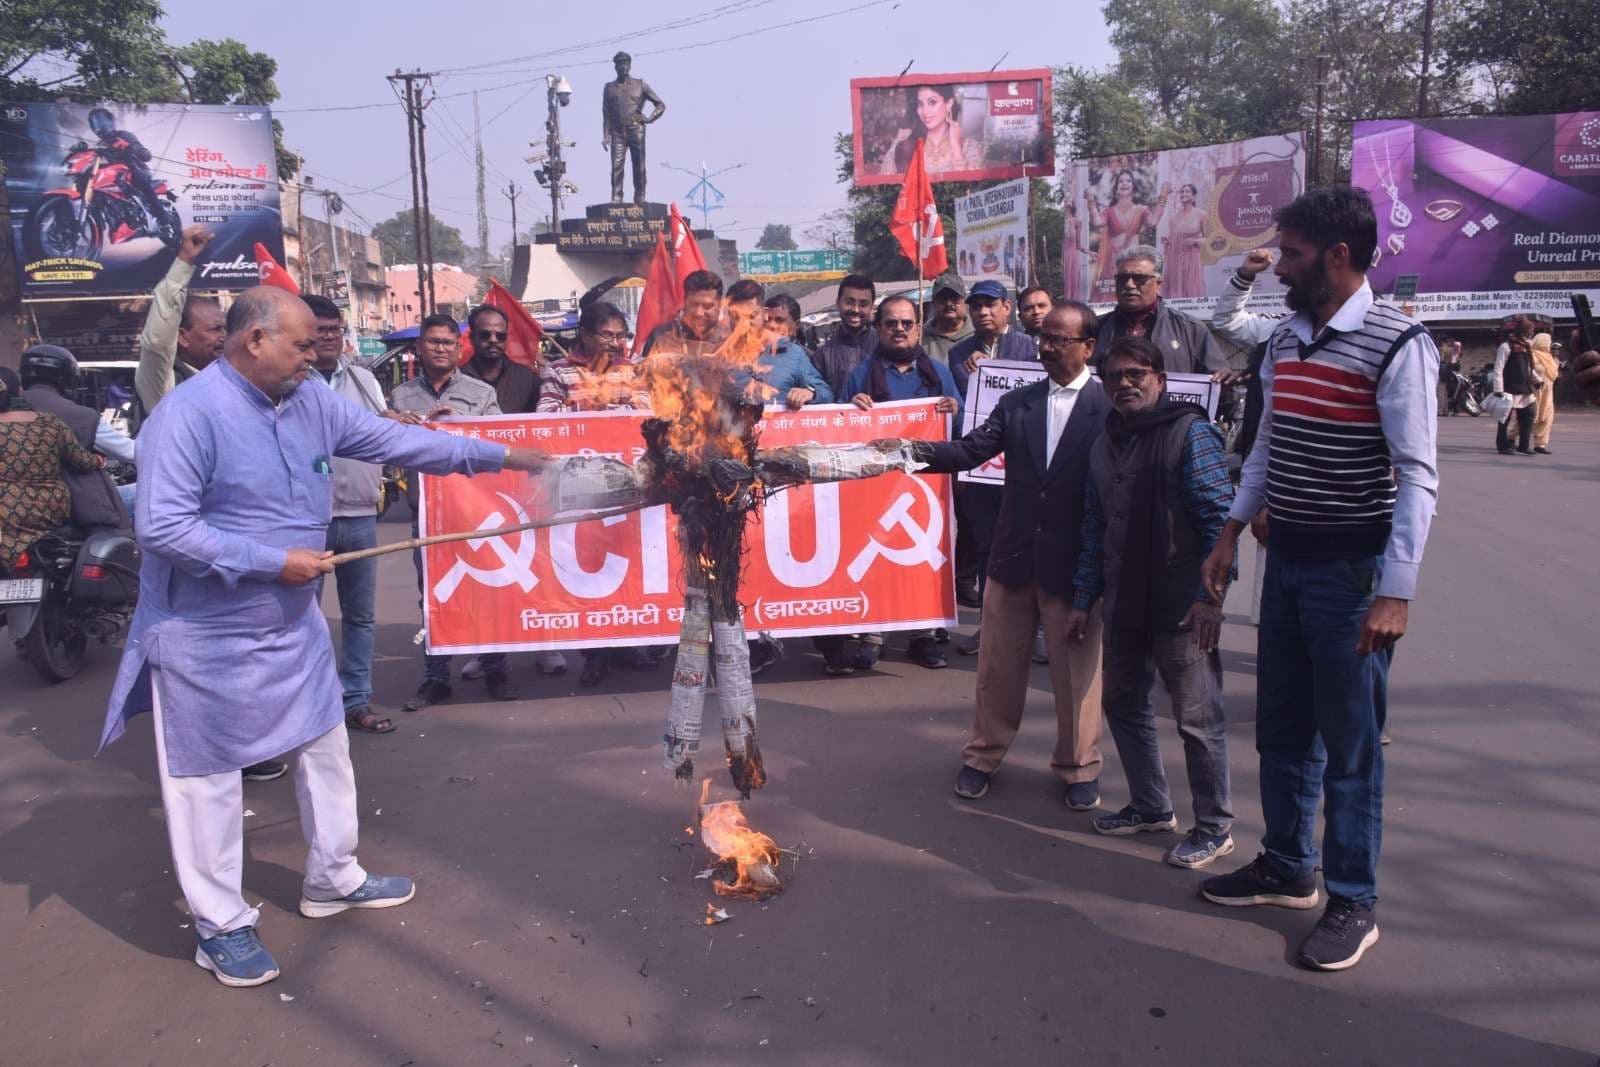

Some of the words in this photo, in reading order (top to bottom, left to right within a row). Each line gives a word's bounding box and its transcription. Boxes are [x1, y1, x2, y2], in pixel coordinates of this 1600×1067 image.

[1560, 153, 1600, 163] CARATL
[1513, 232, 1544, 246] Real
[1528, 249, 1577, 263] Unreal
[201, 254, 259, 278] pulsa
[1524, 272, 1560, 282] Starting
[1562, 271, 1582, 281] from
[1415, 295, 1434, 303] hanti
[1471, 293, 1490, 301] Bank
[1493, 292, 1512, 300] More
[1422, 304, 1445, 312] Grand
[1500, 302, 1518, 310] Main
[985, 375, 1011, 389] HECL
[850, 414, 872, 428] लिए
[878, 411, 902, 425] आगे
[532, 426, 553, 440] एक
[557, 423, 570, 437] हो
[549, 481, 841, 599] CIU
[520, 608, 581, 630] जिला
[585, 603, 661, 627] कमिटी
[754, 590, 869, 625] (झारखण्ड)
